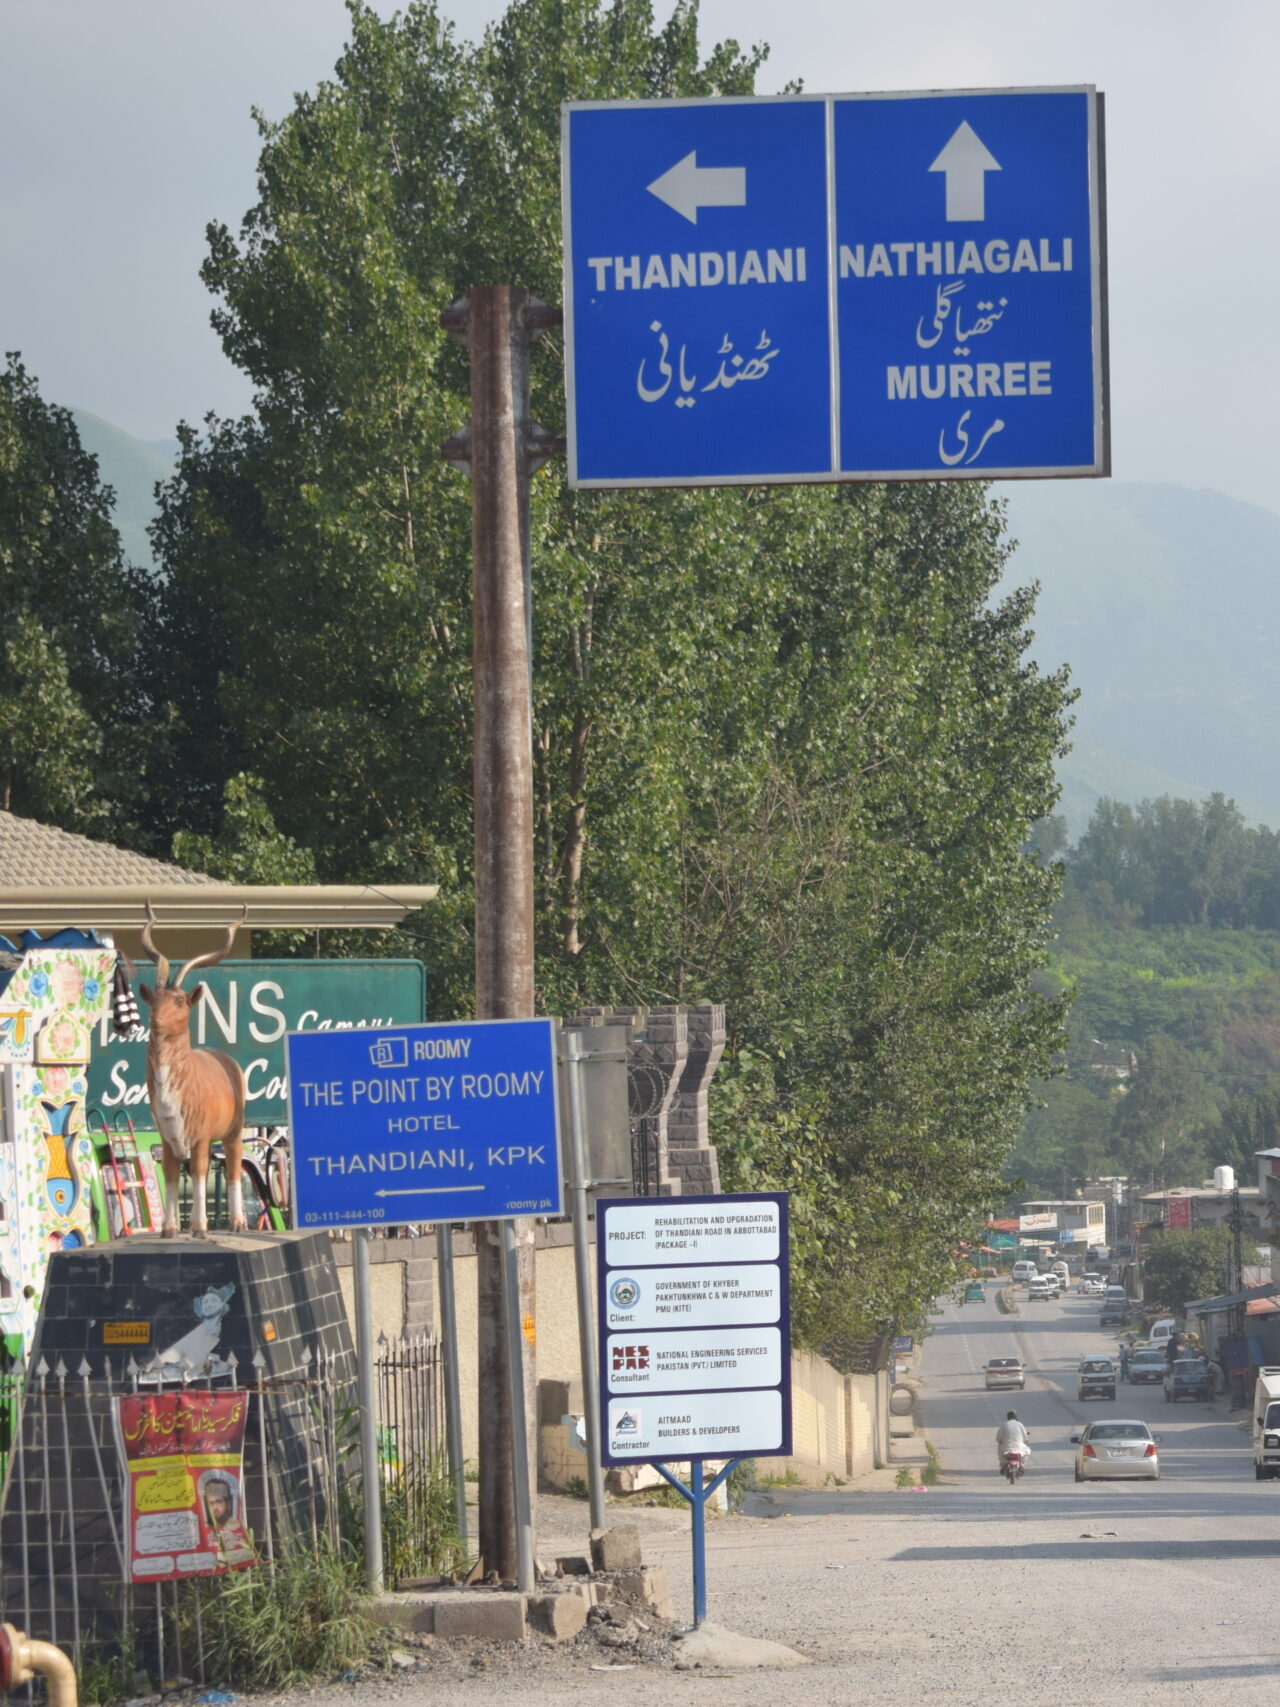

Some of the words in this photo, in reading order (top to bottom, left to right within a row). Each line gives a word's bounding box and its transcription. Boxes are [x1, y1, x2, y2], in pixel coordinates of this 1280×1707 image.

[839, 237, 1074, 279] NATHIAGALI
[587, 247, 807, 292] THANDIANI
[885, 360, 1053, 401] MURREE
[938, 408, 1005, 466] مری
[413, 1037, 472, 1061] ROOMY
[300, 1081, 347, 1107] THE
[351, 1076, 420, 1105] POINT
[426, 1074, 456, 1102] BY
[461, 1070, 546, 1100] ROOMY
[387, 1114, 461, 1134] HOTEL
[308, 1148, 475, 1176] THANDIANI,
[487, 1145, 547, 1167] KPK
[305, 1208, 385, 1223] 03-111-444-100
[655, 1216, 709, 1226] REHABILITATION
[710, 1217, 725, 1225] AND
[726, 1215, 773, 1224] UPGRADATION
[609, 1231, 647, 1240] PROJECT:
[655, 1229, 663, 1238] OF
[665, 1228, 703, 1237] THANDIANI
[704, 1227, 723, 1236] ROAD
[724, 1227, 732, 1235] IN
[733, 1225, 777, 1235] ABBOTTABAD
[655, 1280, 702, 1290] GOVERNMENT
[703, 1280, 711, 1289] OF
[713, 1279, 740, 1288] KHYBER
[655, 1291, 707, 1301] PAKHTUNKHWA
[708, 1291, 713, 1299] C
[715, 1291, 720, 1299] &
[722, 1290, 729, 1299] W
[730, 1290, 773, 1299] DEPARTMENT
[655, 1304, 671, 1313] PMU
[673, 1304, 691, 1313] (KITE)
[657, 1349, 689, 1360] NATIONAL
[691, 1348, 735, 1358] ENGINEERING
[737, 1347, 768, 1356] SERVICES
[657, 1361, 689, 1371] PAKISTAN
[710, 1360, 737, 1369] LIMITED
[611, 1373, 650, 1382] Consultant
[658, 1415, 691, 1425] AITMAAD
[658, 1427, 690, 1437] BUILDERS
[692, 1427, 697, 1435] &
[699, 1425, 741, 1435] DEVELOPERS
[612, 1441, 650, 1450] Contractor
